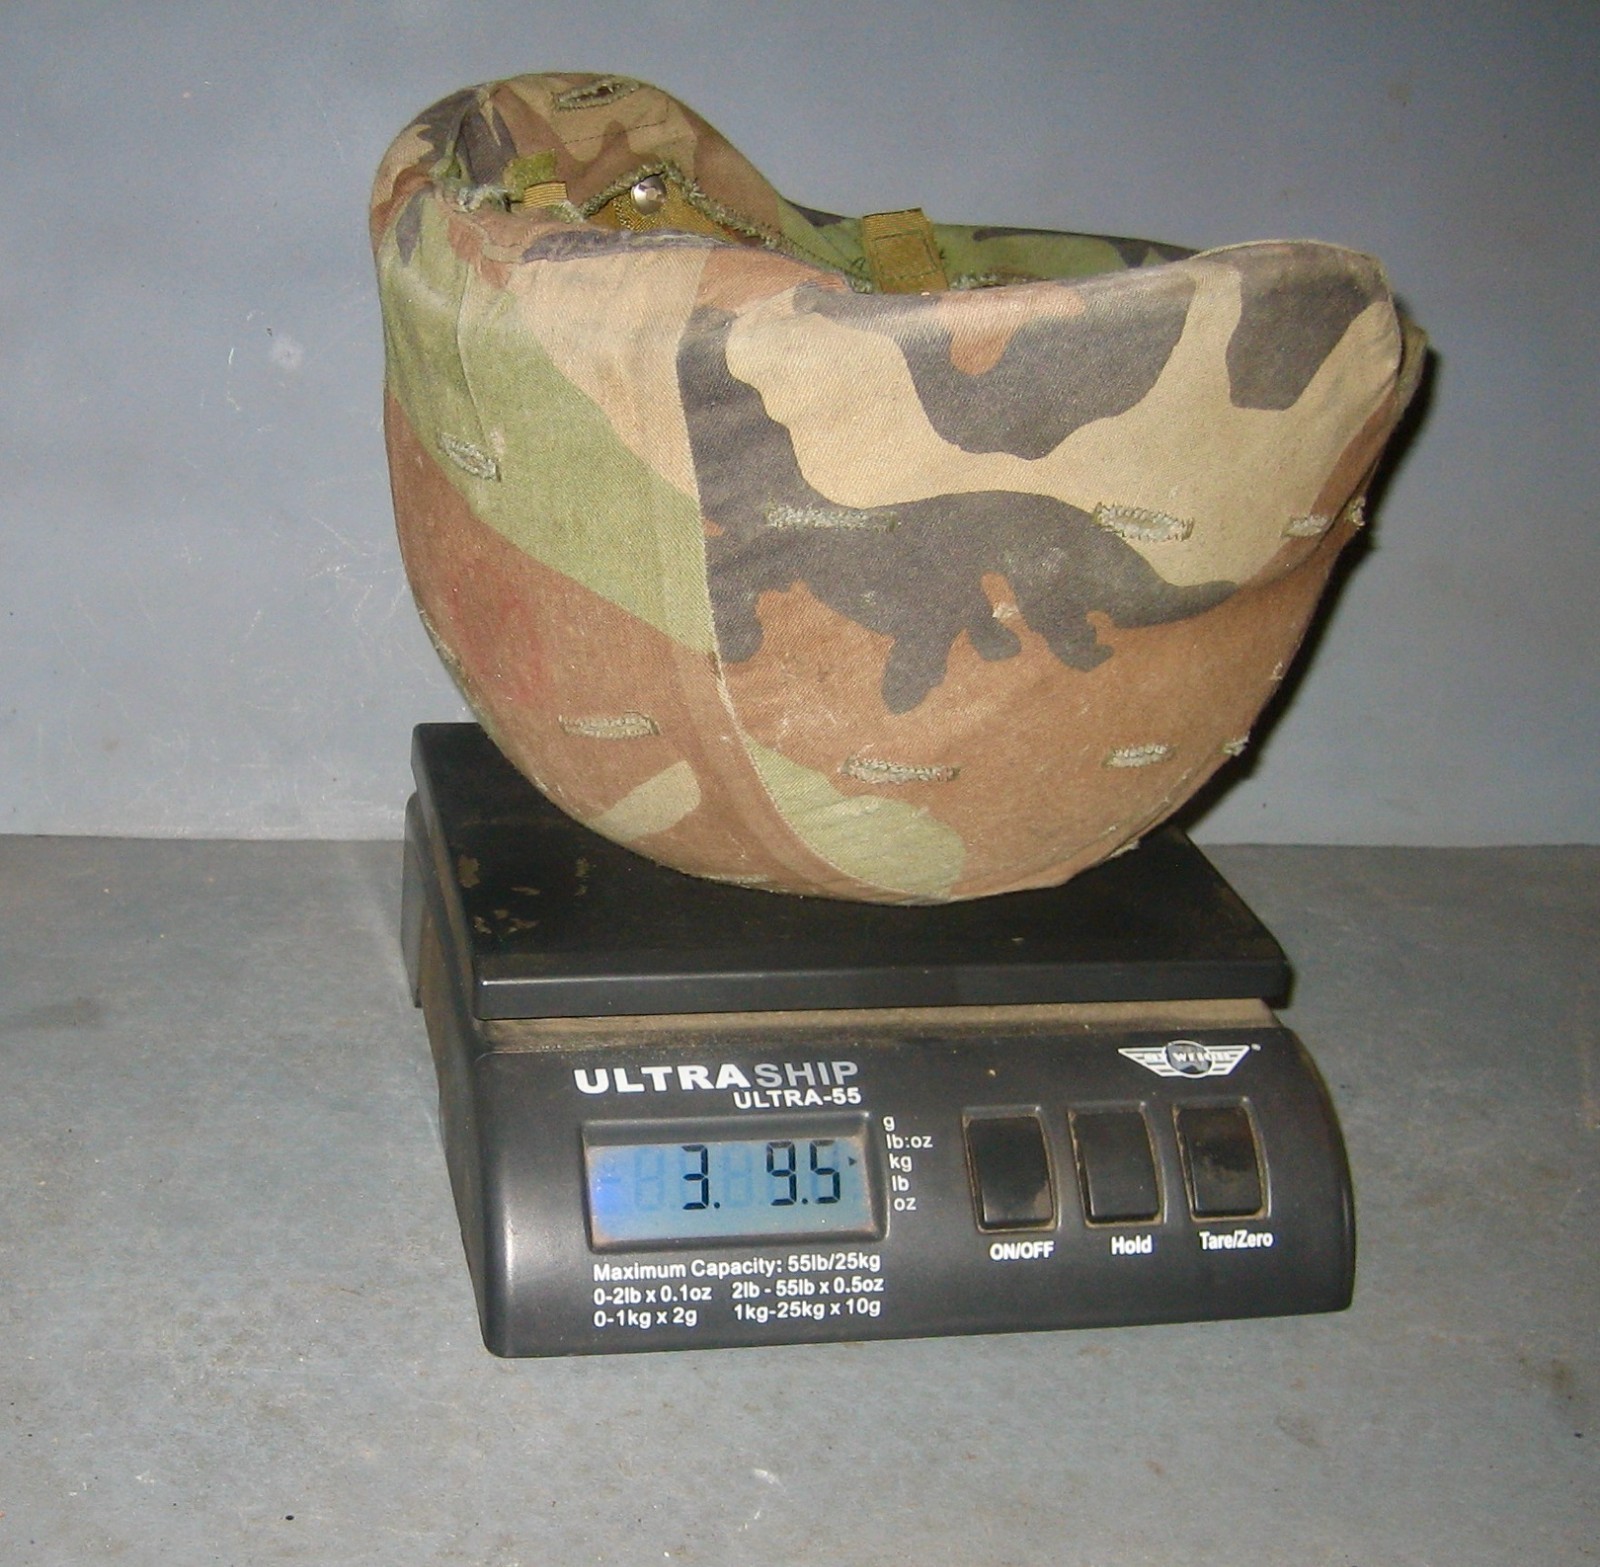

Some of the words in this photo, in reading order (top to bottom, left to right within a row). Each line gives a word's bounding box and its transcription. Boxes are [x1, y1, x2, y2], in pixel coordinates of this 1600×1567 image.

[733, 1087, 862, 1110] ULTRA-55
[882, 1116, 895, 1132] g
[886, 1133, 933, 1150] lb:oz
[766, 1140, 841, 1206] 9.5
[888, 1152, 913, 1173] kg
[891, 1174, 910, 1192] lb
[893, 1197, 917, 1212] oz
[1111, 1234, 1153, 1255] Hold
[1198, 1229, 1274, 1250] Tare/Zero
[989, 1240, 1055, 1261] ON/OFF
[593, 1261, 687, 1282] Maximum
[690, 1257, 782, 1280] Capacity:
[787, 1251, 881, 1273] 55lb/25kg
[593, 1286, 642, 1306] 0-2lb
[645, 1289, 657, 1304] x
[660, 1284, 712, 1303] 0.1oz
[731, 1281, 761, 1299] 2lb
[775, 1278, 816, 1297] 55lb
[819, 1281, 830, 1295] x
[833, 1275, 884, 1294] 0.5oz
[593, 1309, 652, 1330] 0-1kg
[656, 1311, 668, 1325] x
[672, 1306, 698, 1327] 2g
[734, 1301, 825, 1324] 1kg-25kg
[829, 1302, 841, 1316] x
[845, 1297, 881, 1317] 10g
